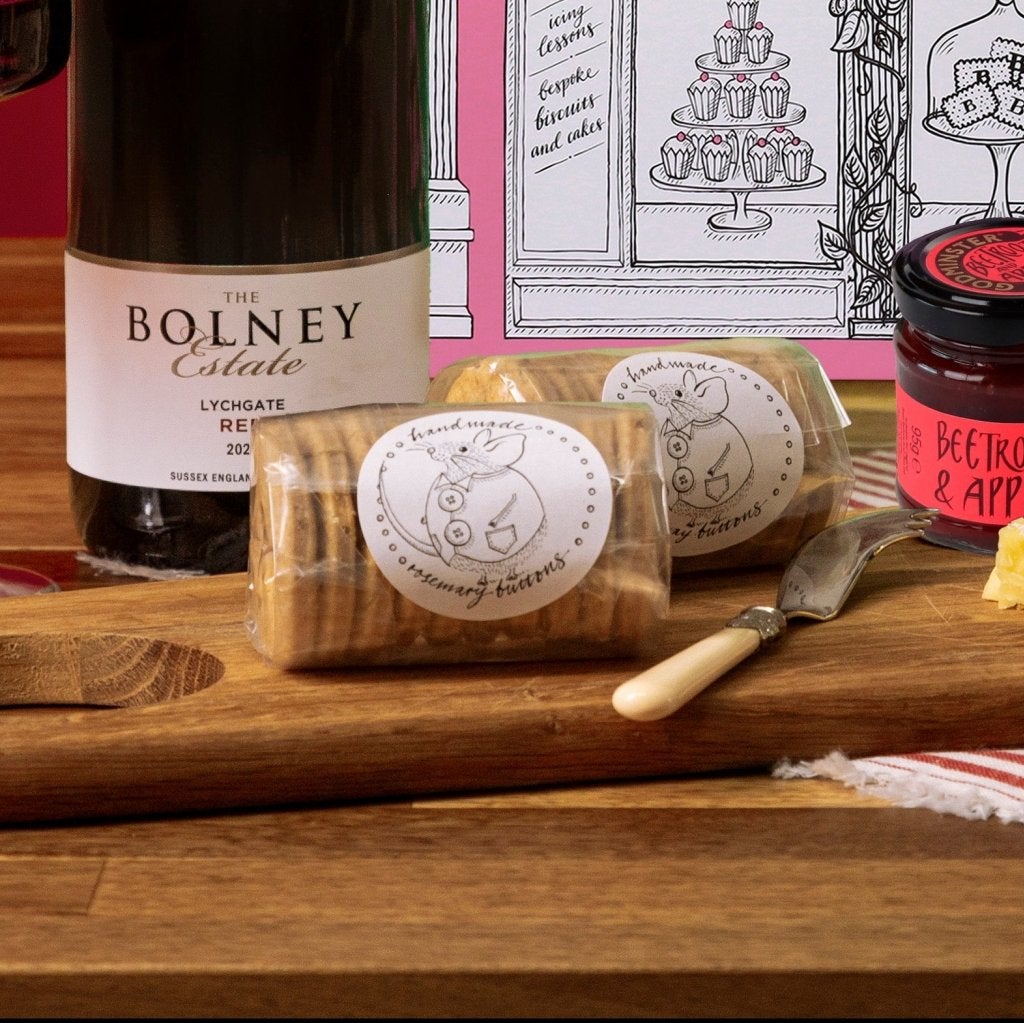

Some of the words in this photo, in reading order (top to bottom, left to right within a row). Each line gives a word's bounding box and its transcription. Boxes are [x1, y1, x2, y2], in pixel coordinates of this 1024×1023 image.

[549, 6, 593, 30] icing
[537, 21, 604, 58] lessons
[537, 66, 600, 102] bespoke
[535, 93, 603, 131] biscuits
[960, 99, 977, 115] B
[530, 129, 563, 159] and
[567, 116, 606, 145] cakes
[936, 233, 1014, 292] GODMINSTER
[223, 291, 260, 303] THE
[126, 302, 362, 346] BOLNEY
[171, 326, 307, 378] Estate
[627, 357, 728, 384] handmade
[200, 399, 285, 411] LYCHGATE
[410, 418, 534, 442] handmade
[226, 443, 250, 455] 202
[170, 471, 208, 482] SUSSEX
[211, 473, 250, 482] ENGLAN
[934, 469, 954, 510] &
[695, 499, 768, 540] buttons
[407, 563, 491, 610] rosemary
[494, 550, 570, 598] buttons
